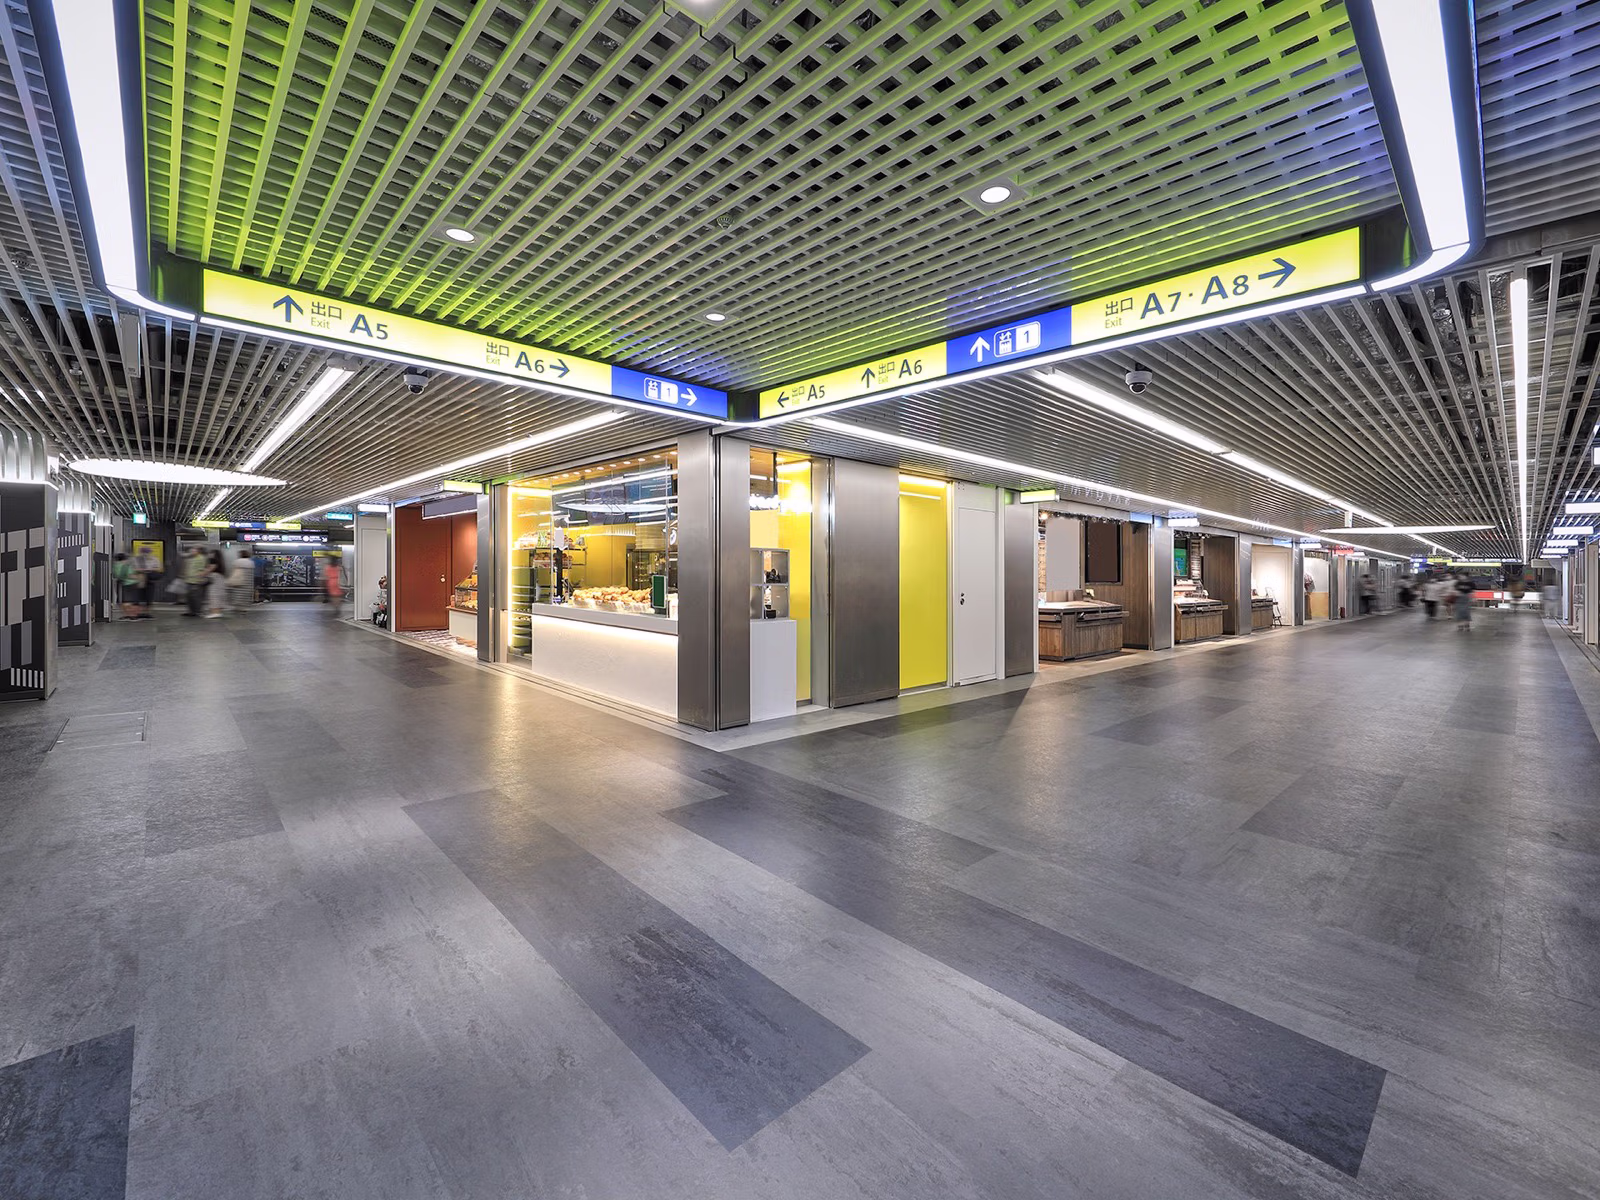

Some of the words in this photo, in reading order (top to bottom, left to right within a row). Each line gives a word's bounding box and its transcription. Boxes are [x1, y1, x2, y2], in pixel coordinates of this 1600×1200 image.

[1104, 297, 1134, 317] 出口
[310, 317, 331, 330] Exit
[311, 301, 342, 320] 出口
[349, 313, 389, 340] A5
[1104, 317, 1123, 329] Exit
[1022, 330, 1031, 344] 1
[486, 342, 510, 357] 出口
[514, 351, 545, 374] A6
[878, 361, 895, 375] 出口
[898, 359, 923, 379] A6
[791, 386, 805, 397] 出口
[807, 384, 826, 402] A5
